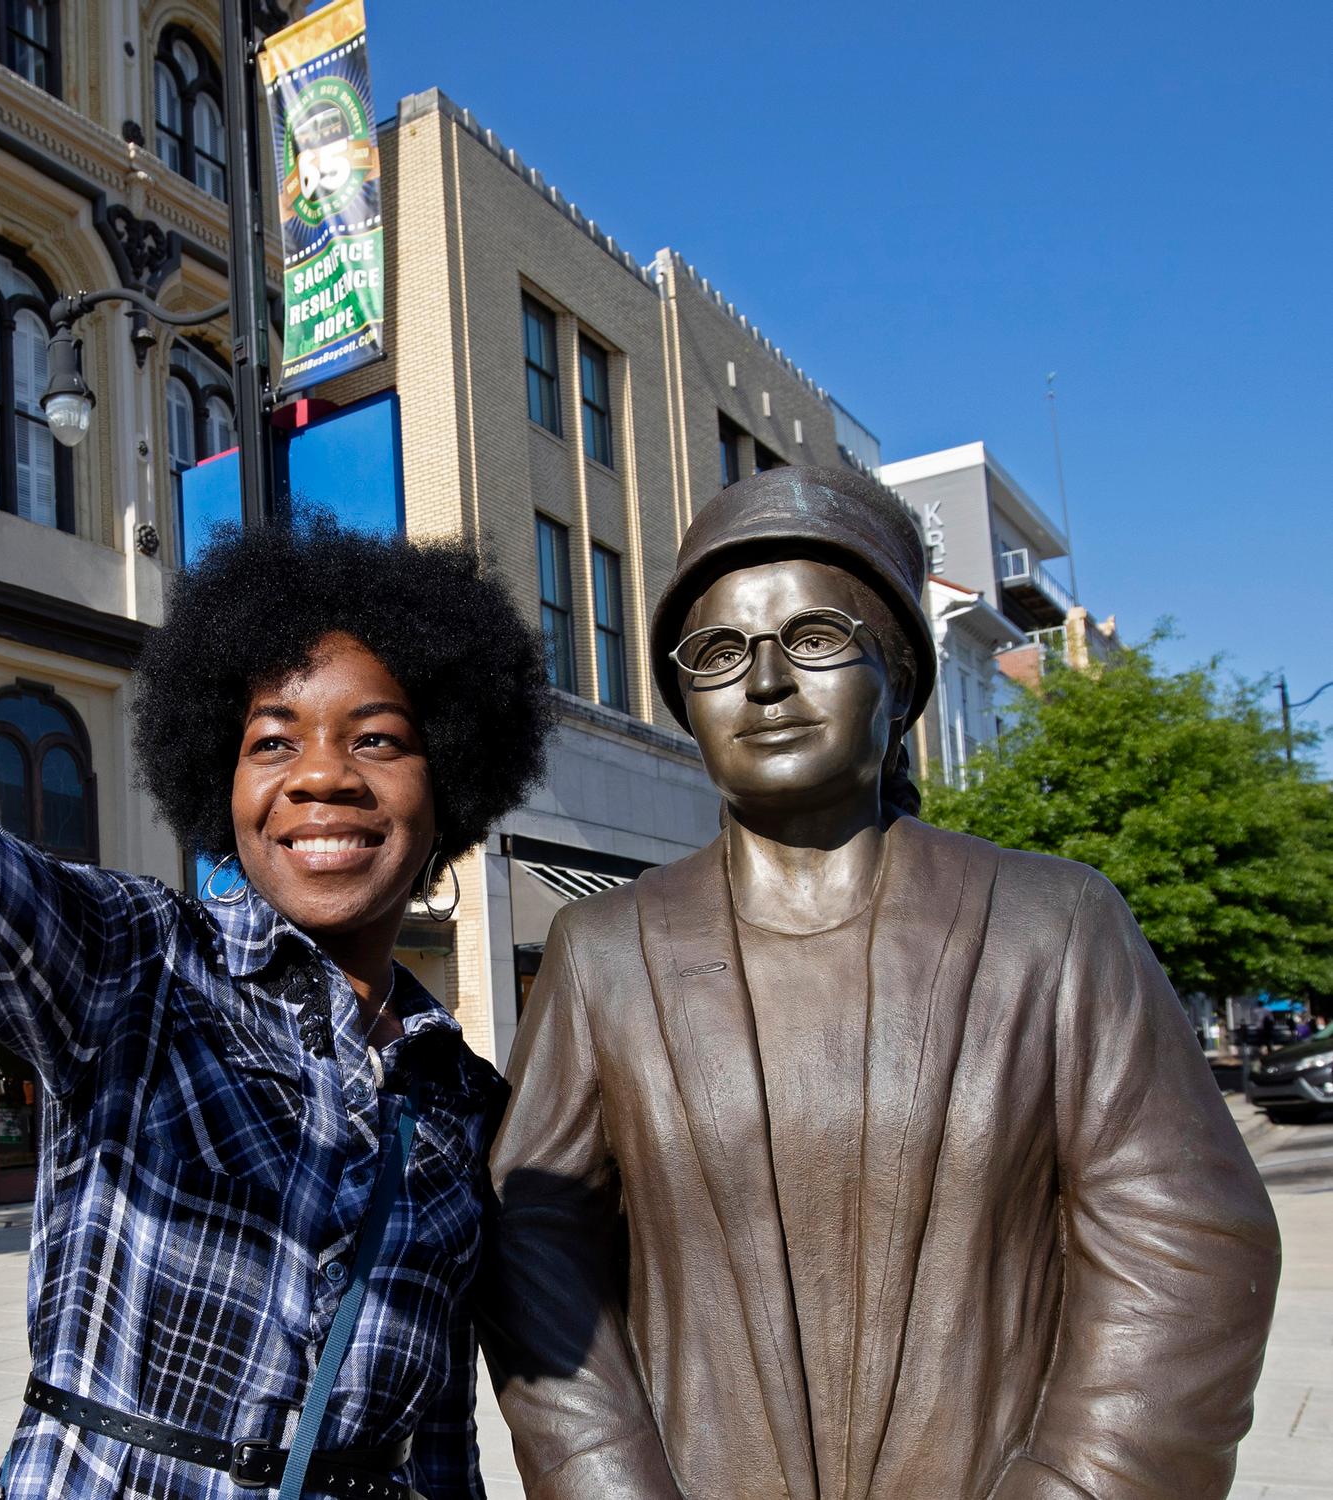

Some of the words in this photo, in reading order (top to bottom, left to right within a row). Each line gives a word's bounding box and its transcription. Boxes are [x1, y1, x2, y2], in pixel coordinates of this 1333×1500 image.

[293, 239, 375, 294] SACRIFICE
[289, 267, 380, 326] RESILIENCE
[314, 304, 355, 344] HOPE
